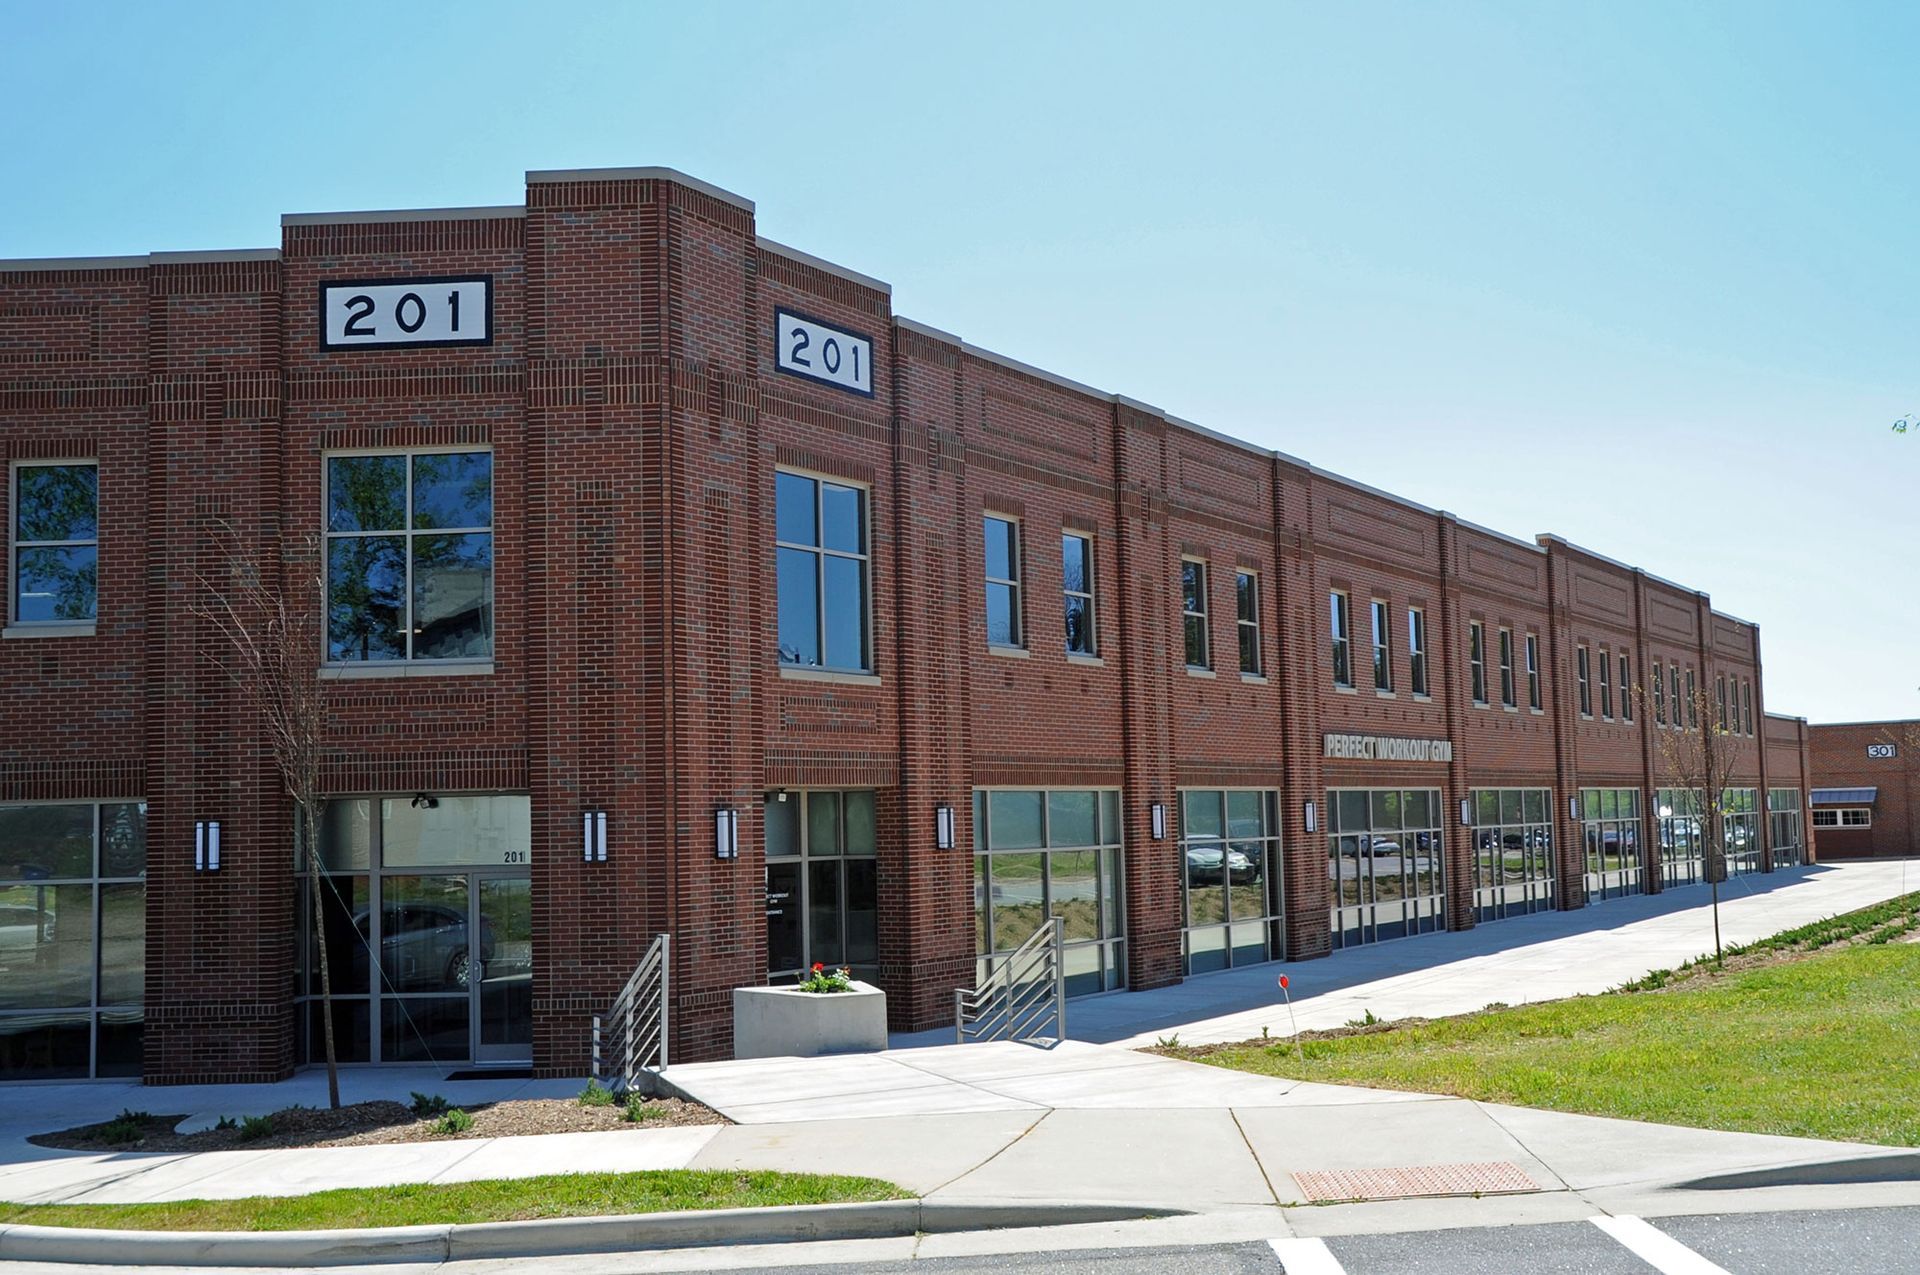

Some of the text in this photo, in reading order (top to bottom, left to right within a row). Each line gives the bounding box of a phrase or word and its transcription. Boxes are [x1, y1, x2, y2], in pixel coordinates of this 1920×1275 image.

[343, 291, 459, 337] 201
[790, 327, 859, 382] 201
[1326, 734, 1452, 762] PERFECT WORKOUT GYM
[1869, 746, 1895, 757] 301
[504, 850, 523, 863] 201
